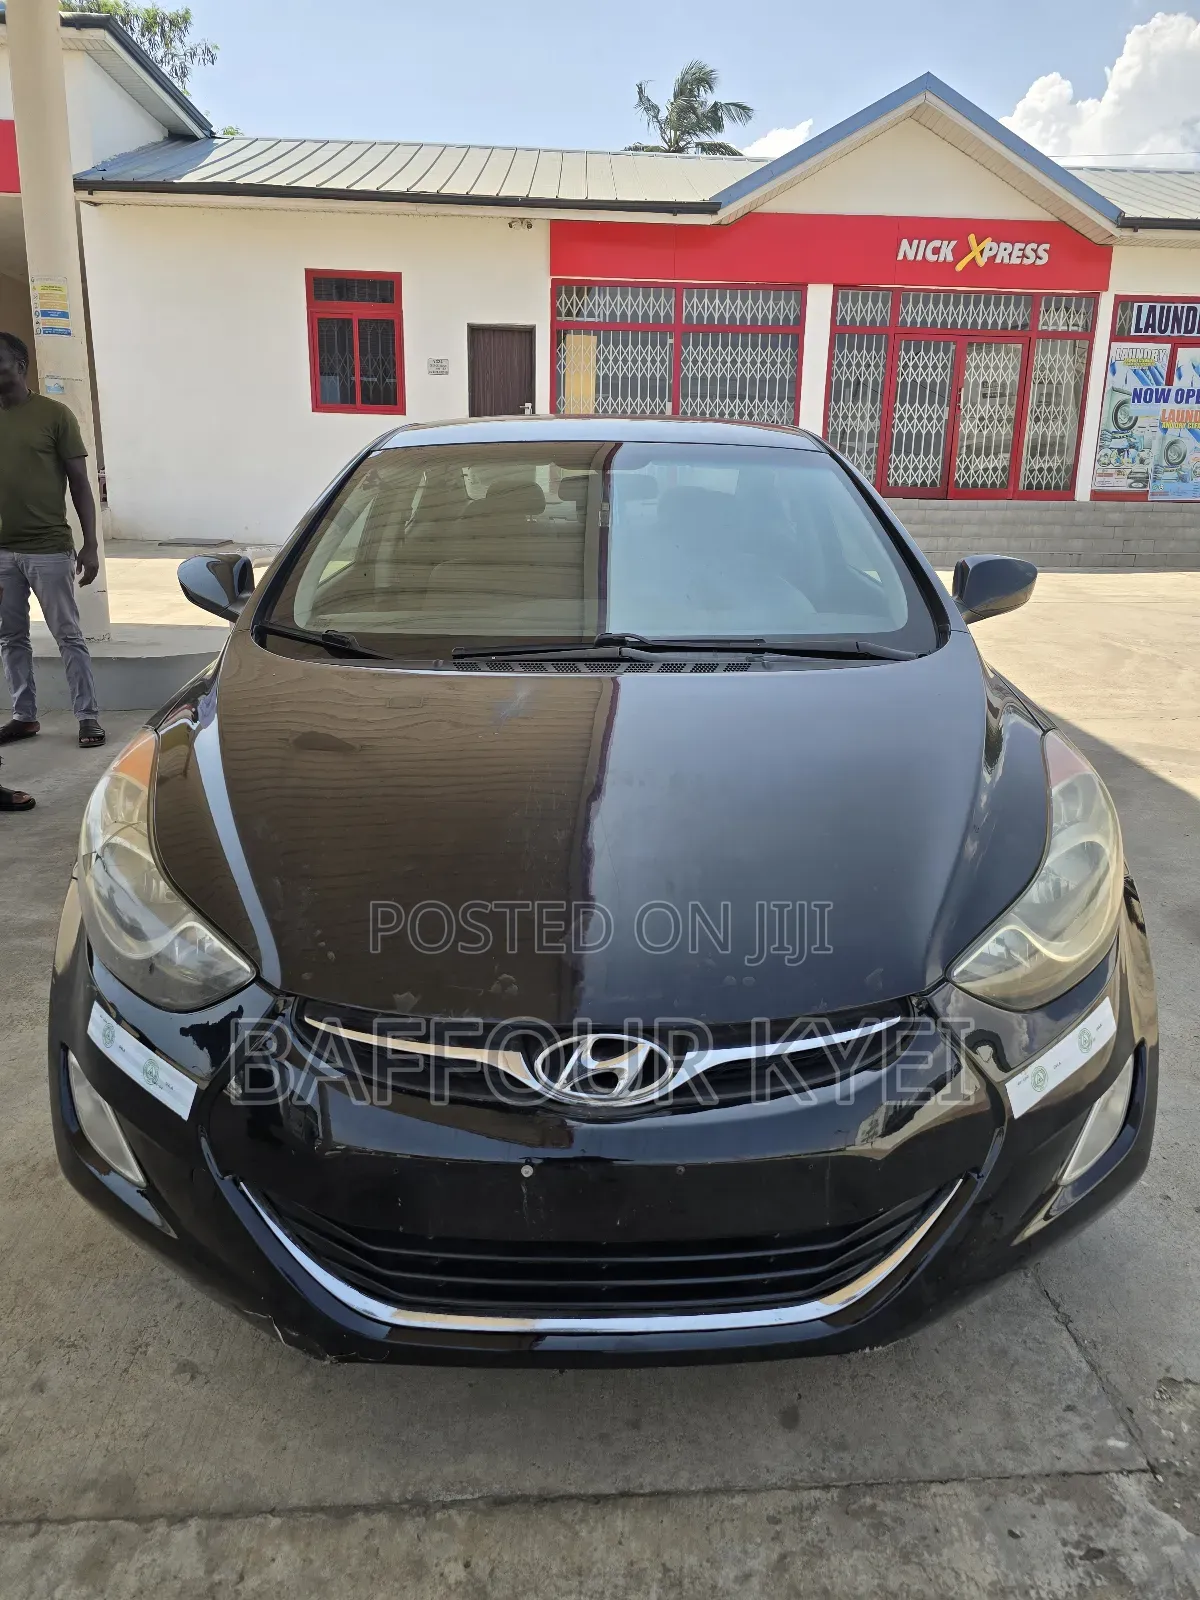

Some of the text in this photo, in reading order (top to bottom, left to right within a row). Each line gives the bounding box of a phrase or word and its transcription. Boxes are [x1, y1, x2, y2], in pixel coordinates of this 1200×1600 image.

[896, 233, 1050, 272] NICK XPRESS
[1134, 304, 1200, 334] LAUND
[1131, 387, 1172, 403] NOW
